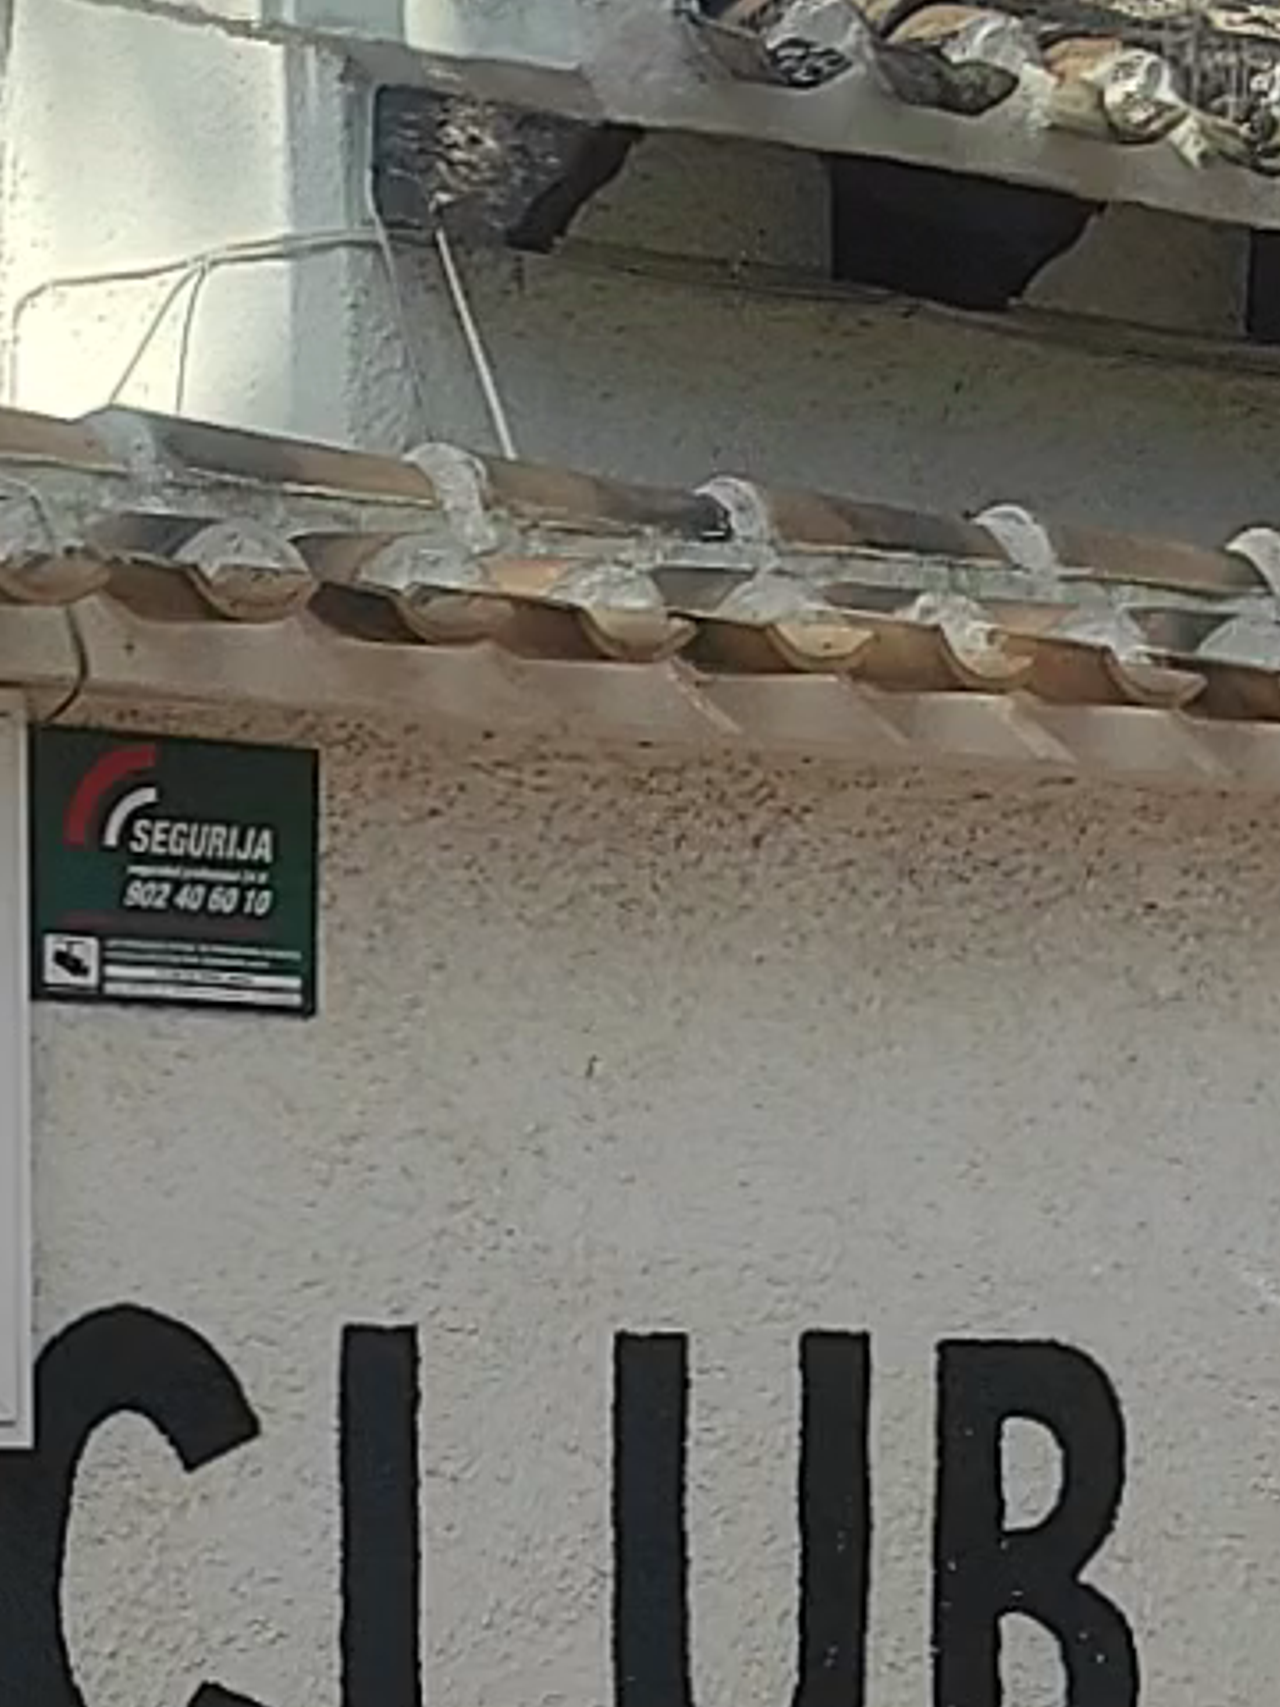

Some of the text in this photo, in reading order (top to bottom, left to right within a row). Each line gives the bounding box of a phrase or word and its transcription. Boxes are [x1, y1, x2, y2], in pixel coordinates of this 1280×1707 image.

[129, 818, 274, 864] SEGURIJA
[123, 880, 274, 916] 902 40 60 10
